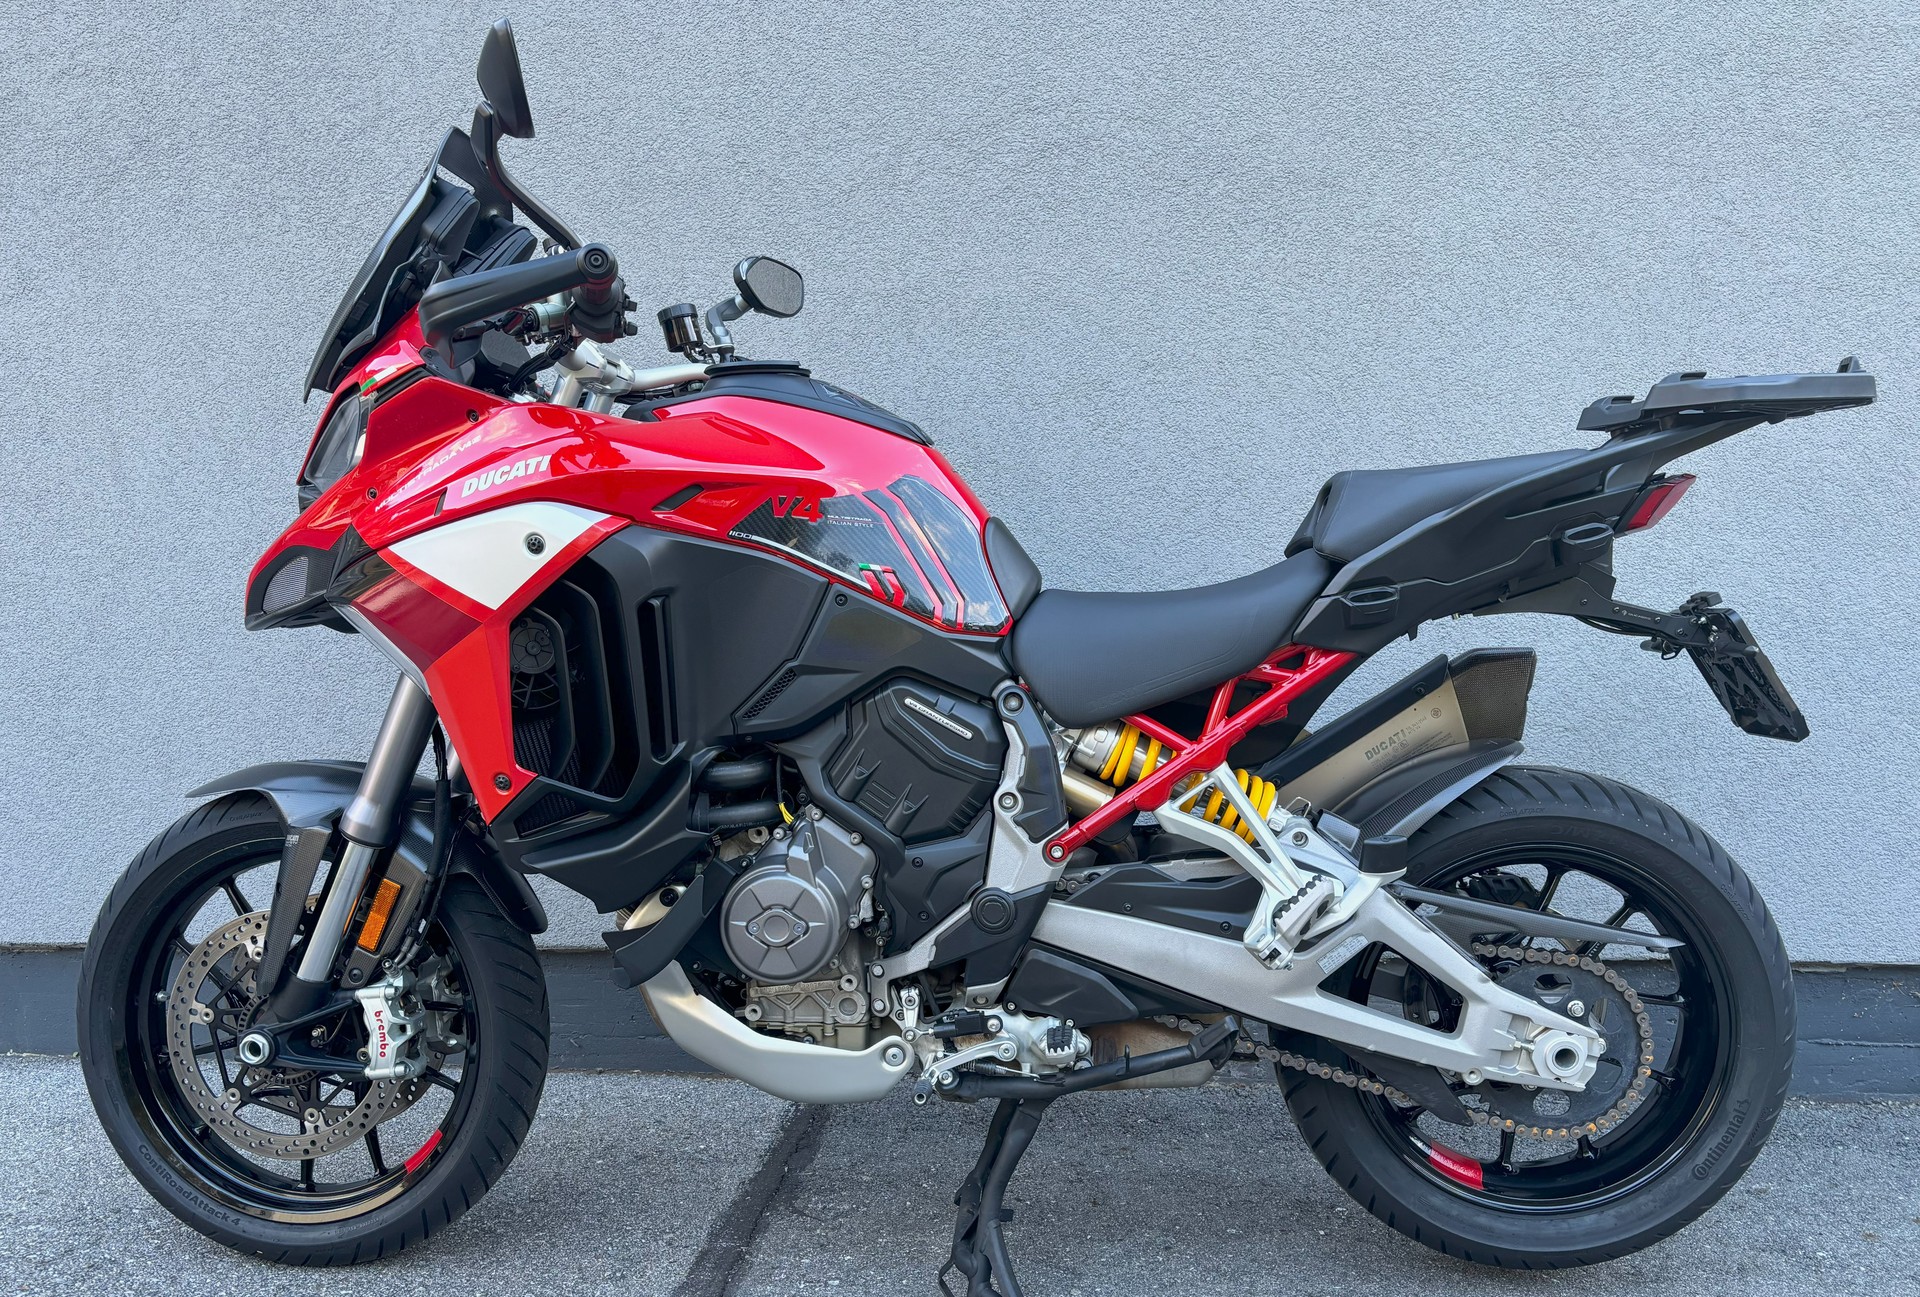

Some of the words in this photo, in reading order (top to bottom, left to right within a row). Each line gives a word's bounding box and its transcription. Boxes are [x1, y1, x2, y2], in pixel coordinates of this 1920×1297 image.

[461, 454, 553, 498] DUCATI
[771, 495, 824, 524] V4
[1364, 729, 1407, 761] DUCATI
[374, 1010, 390, 1058] brembo
[1691, 1107, 1748, 1181] Continental
[138, 1144, 230, 1222] ContiRoadAttack
[231, 1217, 241, 1226] 4
